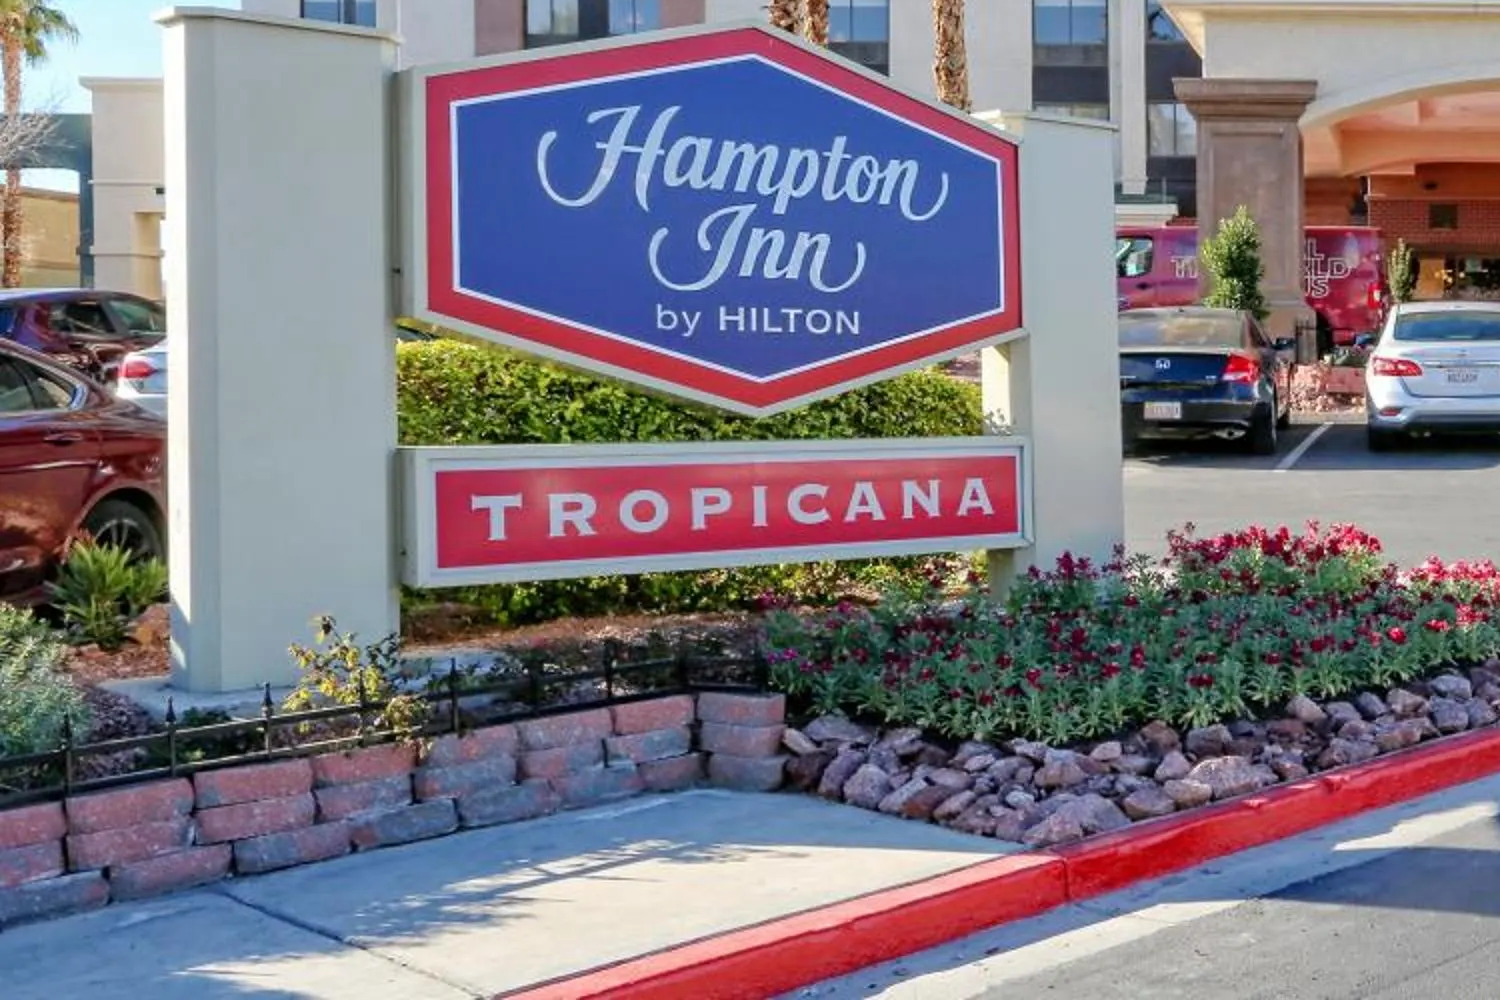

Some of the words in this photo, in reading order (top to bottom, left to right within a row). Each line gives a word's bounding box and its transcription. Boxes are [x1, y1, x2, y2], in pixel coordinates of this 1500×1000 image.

[537, 105, 948, 221] Hampton
[649, 203, 867, 292] Inn
[656, 303, 701, 337] by
[719, 305, 860, 335] HILTON
[470, 476, 996, 542] TROPICANA
